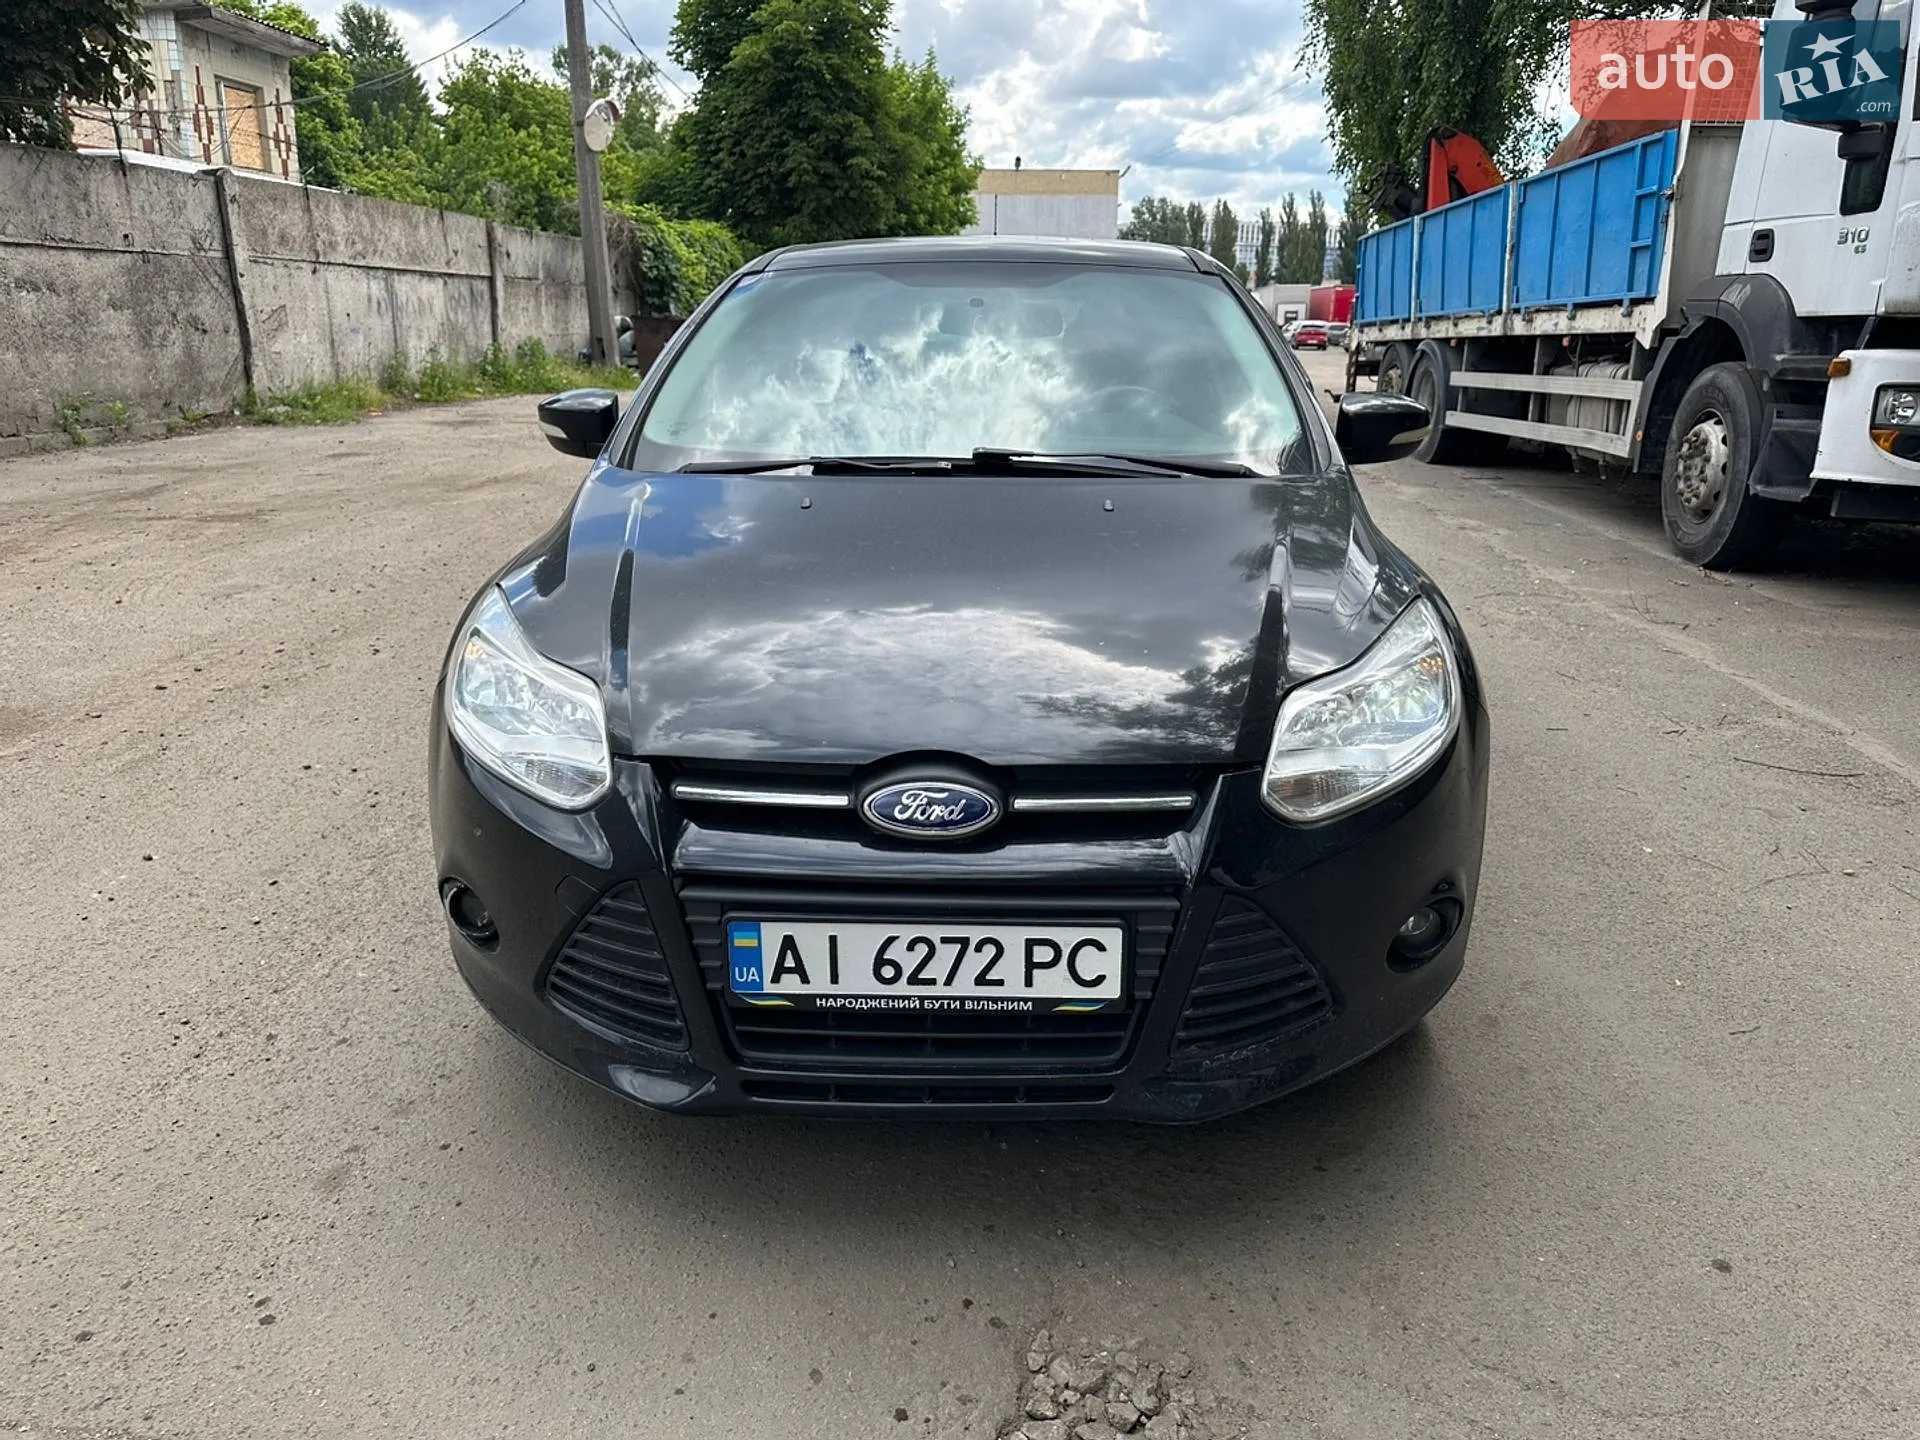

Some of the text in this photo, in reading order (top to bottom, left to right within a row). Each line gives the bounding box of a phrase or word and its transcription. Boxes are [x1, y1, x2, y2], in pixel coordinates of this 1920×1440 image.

[1837, 227, 1870, 245] 310
[894, 790, 966, 820] Ford
[872, 935, 1004, 986] 6272
[1023, 937, 1107, 988] PC
[735, 966, 759, 983] UA
[816, 997, 1033, 1011] НАРОДЖЕНИЙ БУТИ ВІЛЬНИМ
